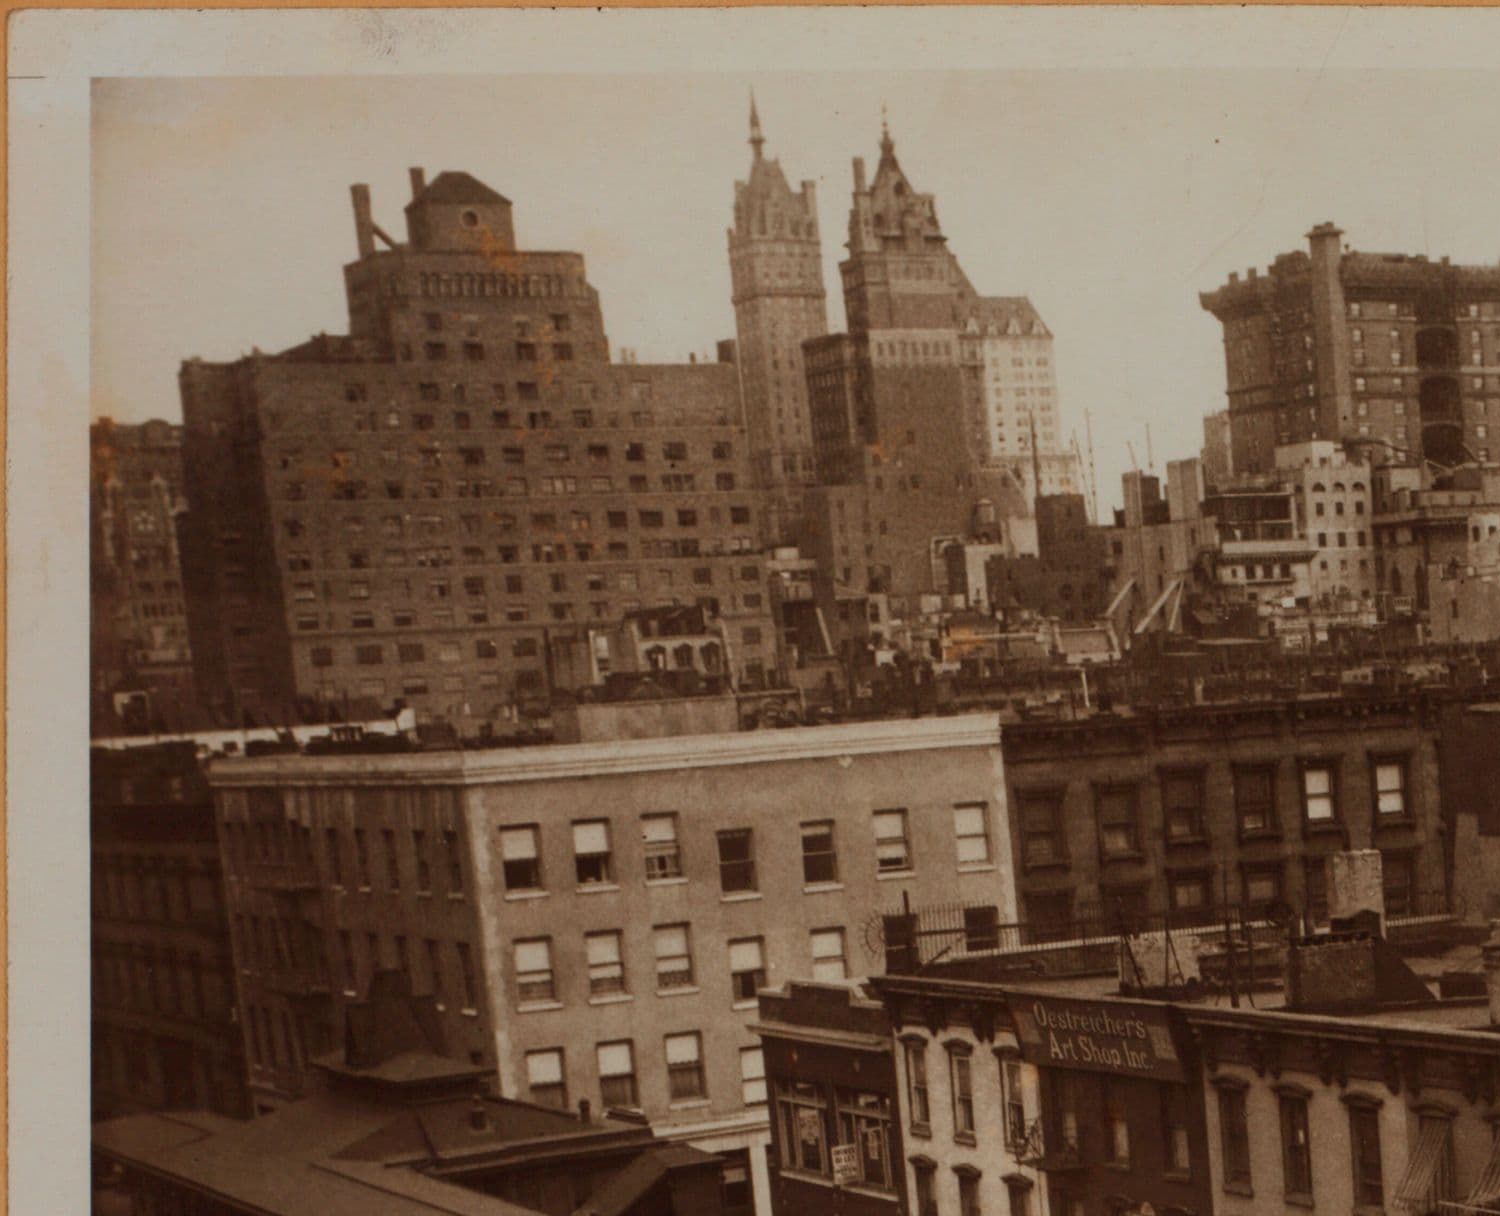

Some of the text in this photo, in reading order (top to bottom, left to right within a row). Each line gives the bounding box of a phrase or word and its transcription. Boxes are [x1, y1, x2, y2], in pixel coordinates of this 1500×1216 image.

[1033, 1000, 1146, 1039] Oestreicher's
[1050, 1031, 1153, 1070] Art Shop Inc.
